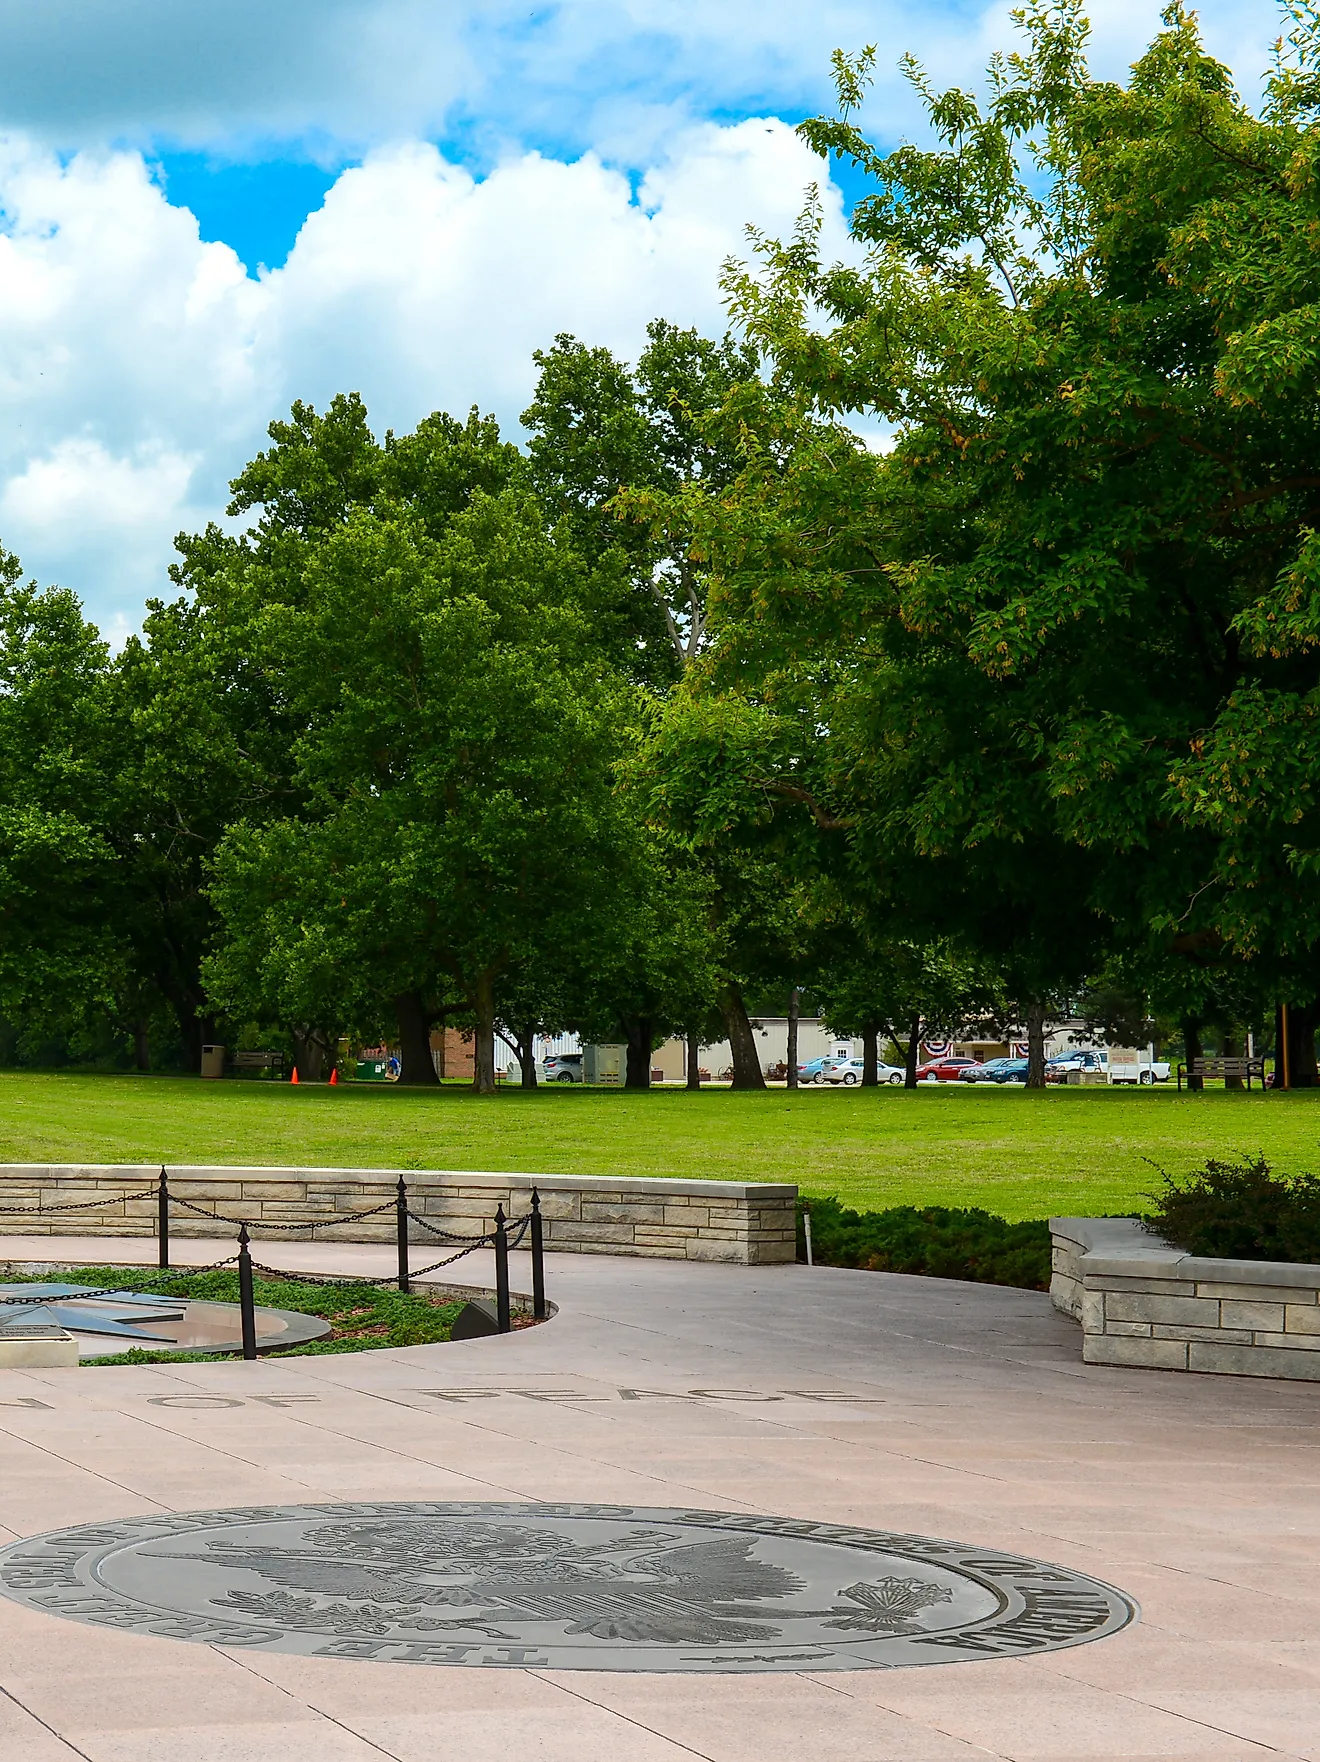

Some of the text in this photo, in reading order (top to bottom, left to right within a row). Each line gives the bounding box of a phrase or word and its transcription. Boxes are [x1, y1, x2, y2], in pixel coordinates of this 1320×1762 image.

[147, 1394, 323, 1409] OF
[418, 1388, 886, 1403] PEACE
[0, 1503, 1111, 1666] THE GREAT SEAL OF THE UNITED STATES OF AMERICA
